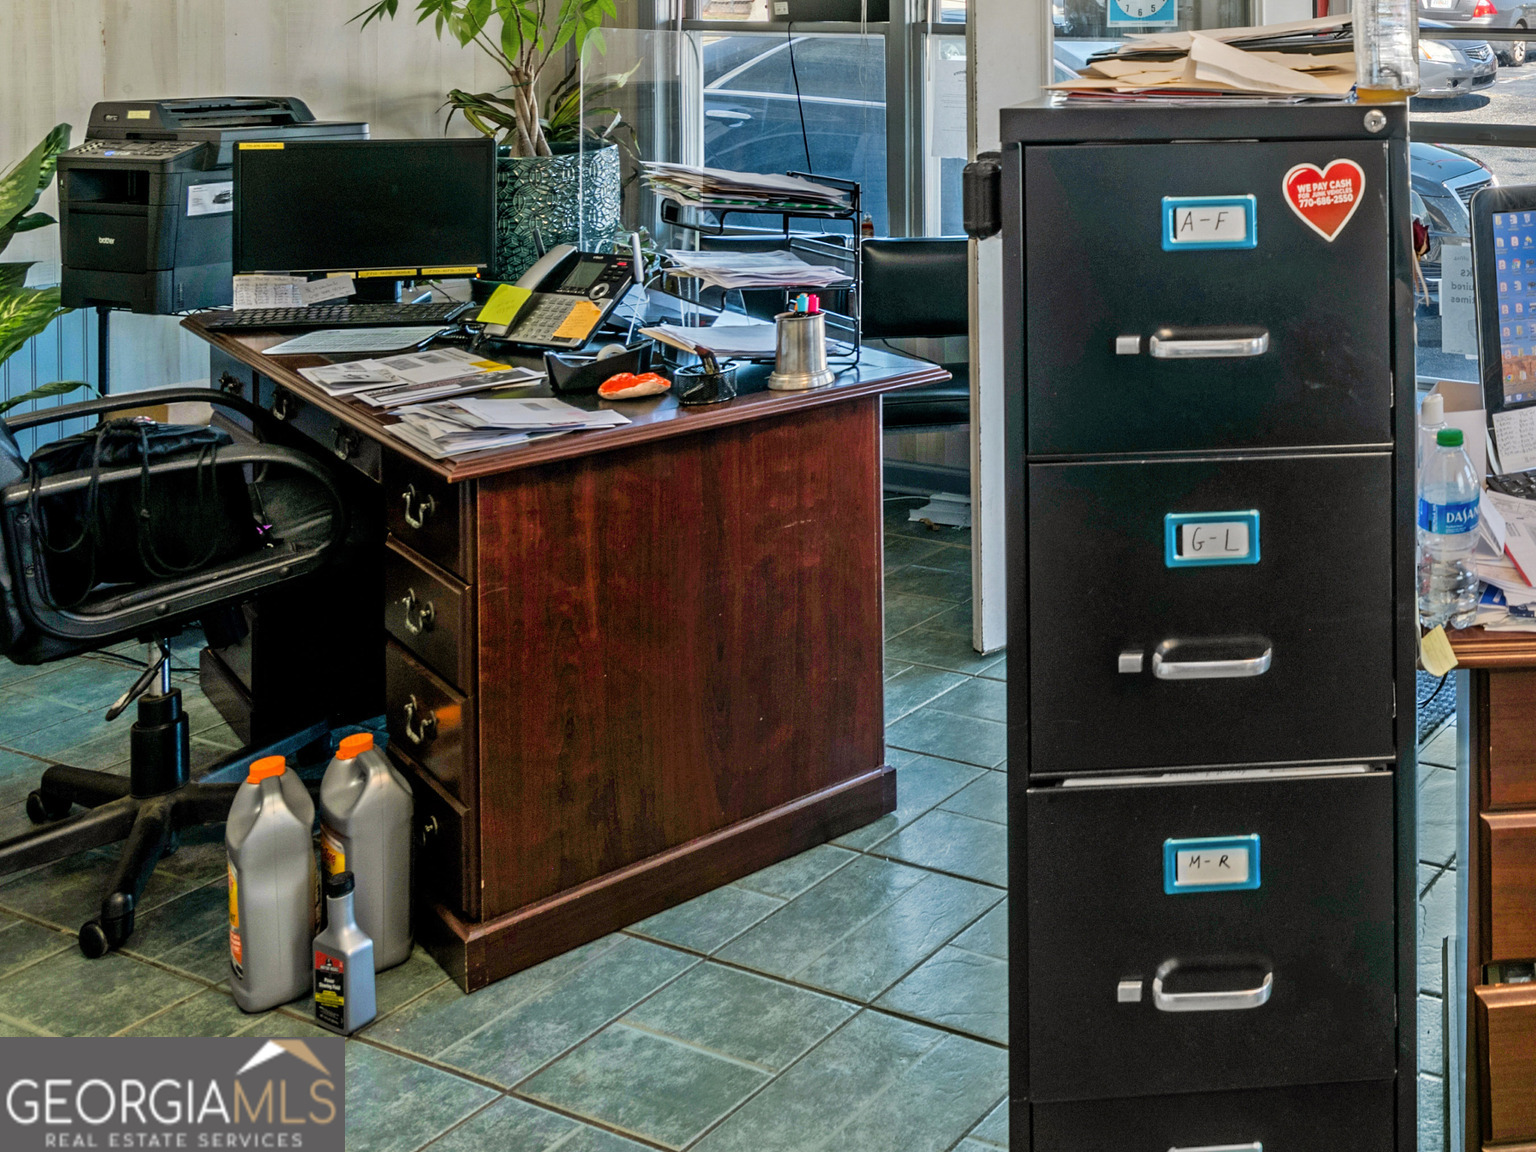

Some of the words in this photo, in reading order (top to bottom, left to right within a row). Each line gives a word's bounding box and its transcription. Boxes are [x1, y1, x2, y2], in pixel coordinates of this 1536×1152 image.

[1126, 4, 1130, 12] 7
[1138, 8, 1142, 16] 6
[1151, 4, 1156, 13] 5
[1297, 183, 1311, 194] WE
[1312, 181, 1328, 192] PAY
[1329, 178, 1352, 189] CASH
[1312, 190, 1326, 198] JUNK
[1327, 187, 1353, 196] VEHICLES
[1299, 193, 1354, 208] 770-686-2550
[98, 236, 115, 244] brother
